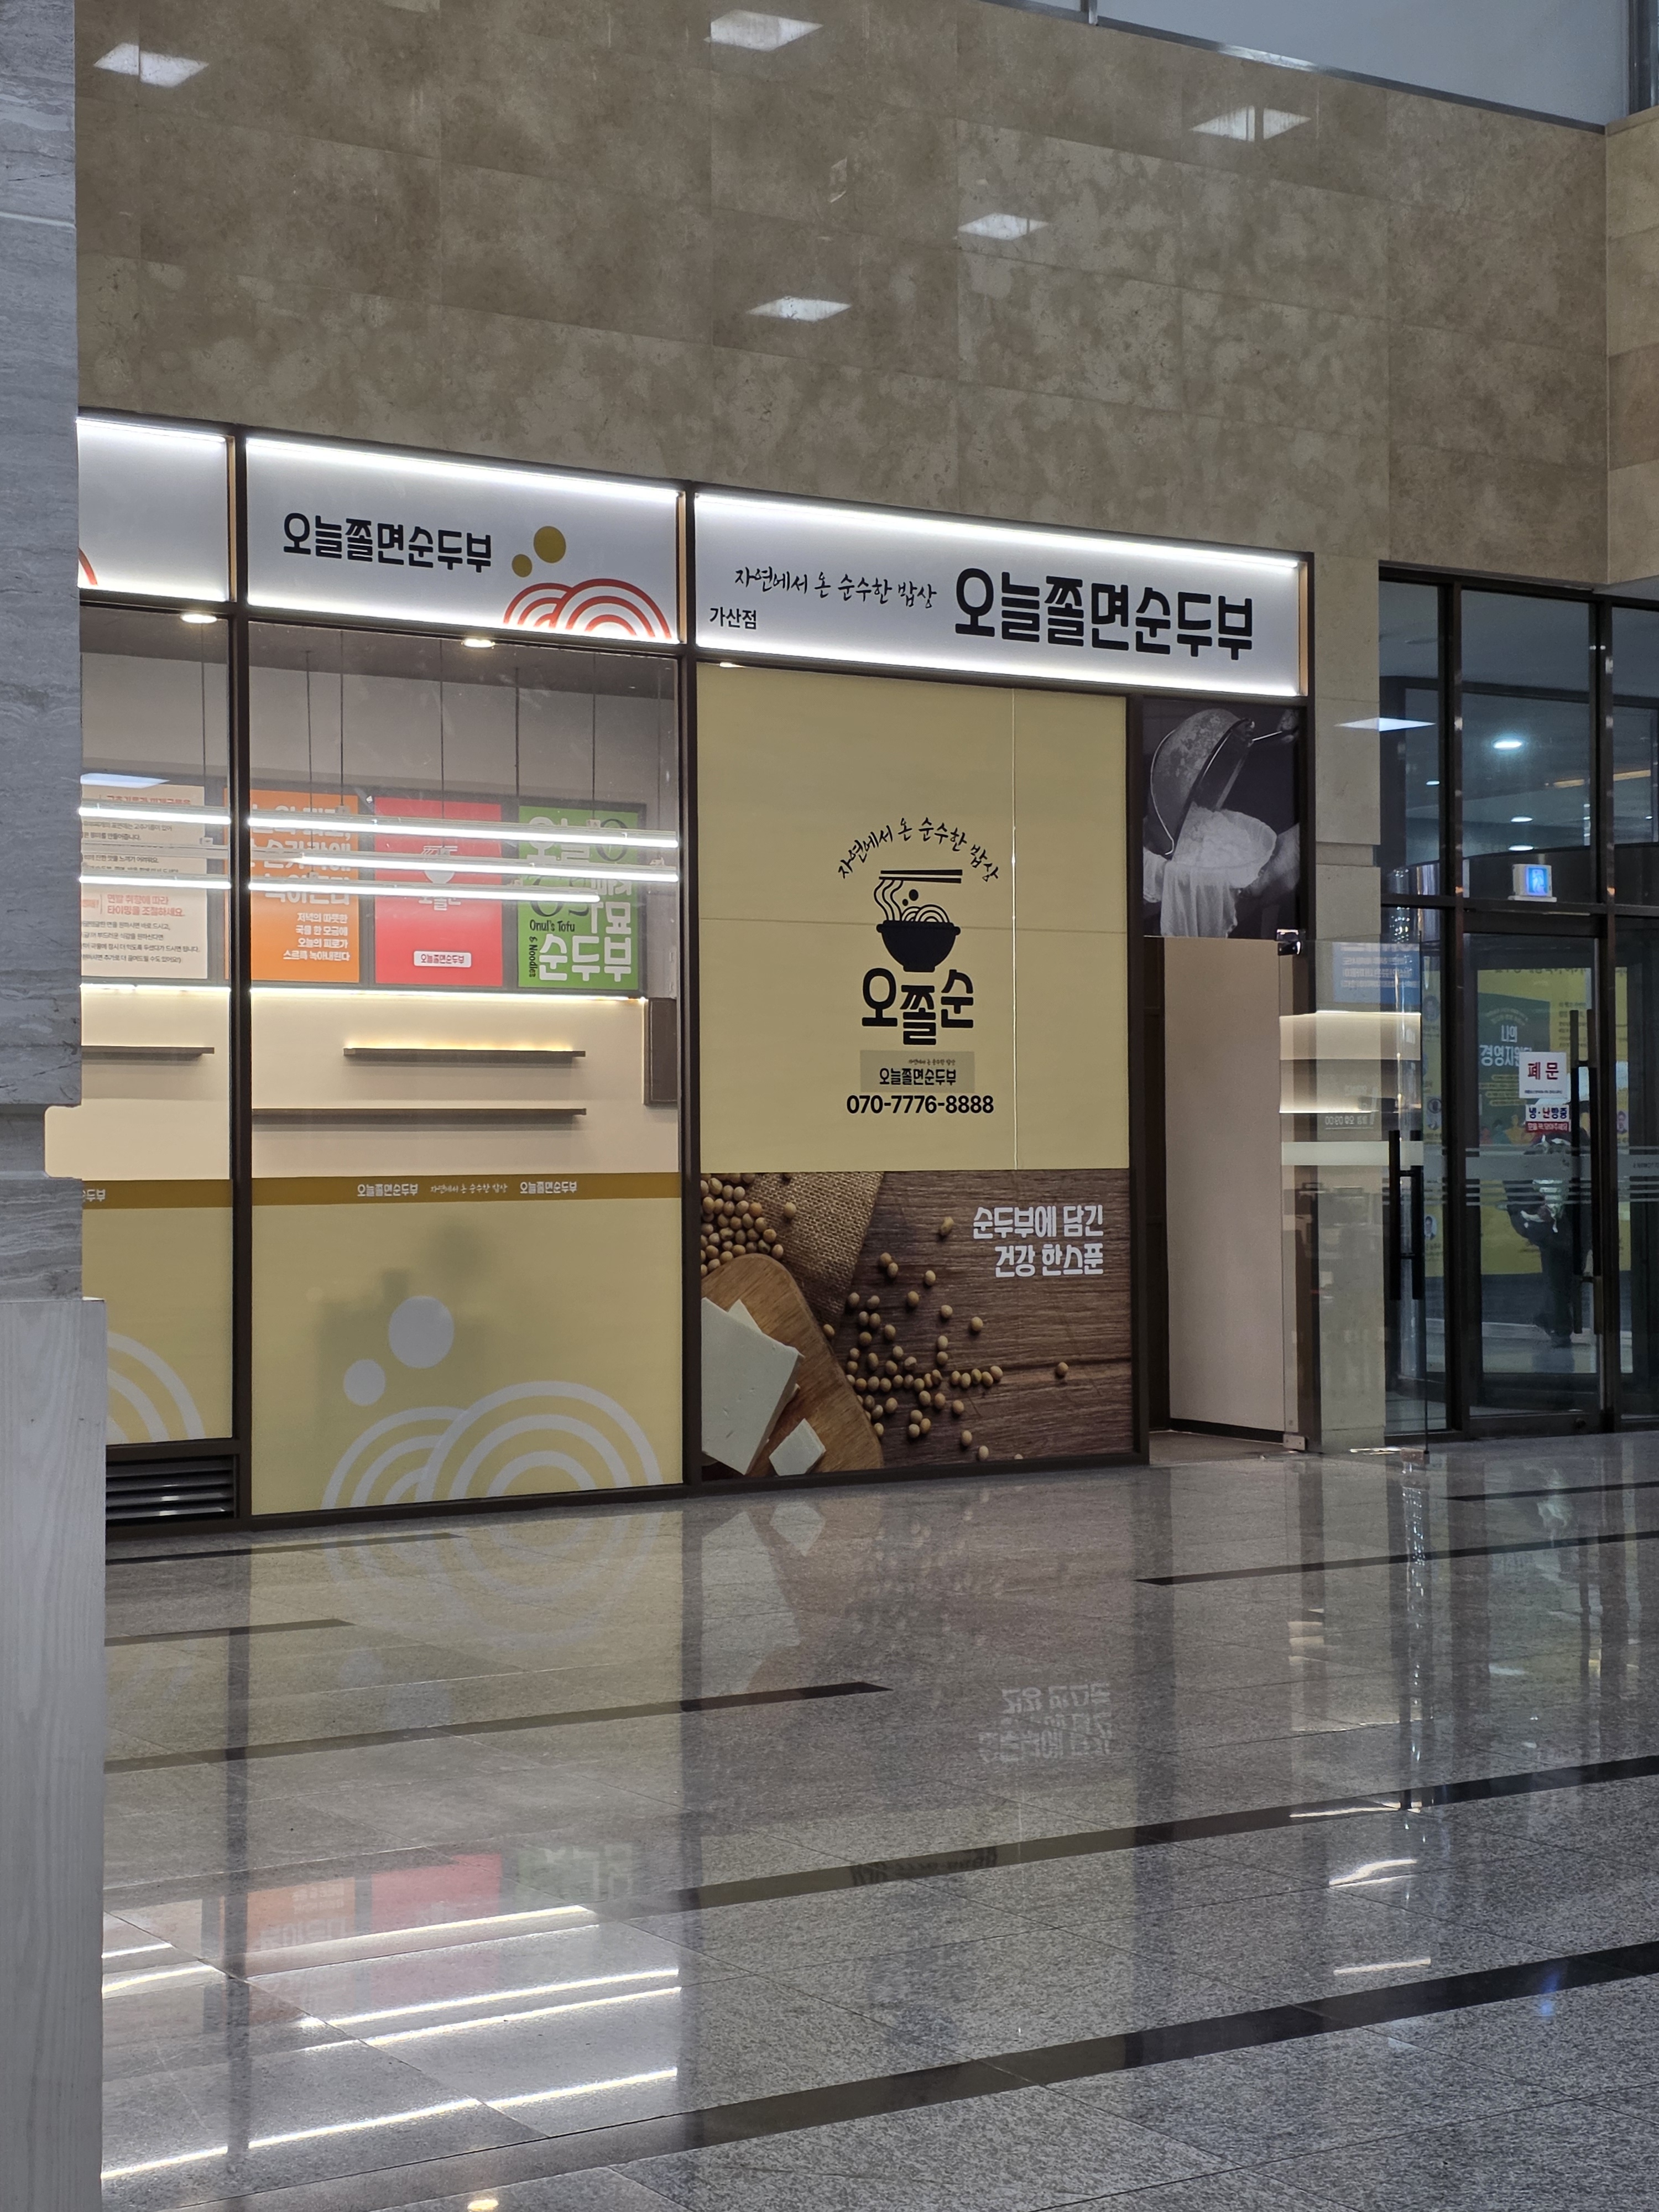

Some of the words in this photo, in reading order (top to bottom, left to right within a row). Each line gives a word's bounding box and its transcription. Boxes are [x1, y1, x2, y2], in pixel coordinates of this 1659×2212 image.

[283, 512, 492, 573] 오늘쫄면순두부
[734, 566, 809, 595] 자연에서
[813, 571, 832, 598] 온
[837, 573, 893, 604] 순수한
[898, 581, 937, 609] 밥상
[709, 606, 758, 630] 가산점
[954, 567, 1253, 661] 오늘쫄면순두부
[837, 825, 894, 880] 자연에서
[898, 817, 913, 842] 온
[918, 817, 968, 852] 순수한
[970, 844, 999, 883] 밥상
[298, 938, 322, 948] 오늘의
[529, 919, 555, 932] Onul's
[557, 920, 575, 932] Tofu
[539, 933, 632, 982] 순두부
[862, 967, 974, 1046] 오쫄순
[879, 1068, 957, 1086] 오늘쫄면순두부
[847, 1095, 994, 1114] 070-7776-8888
[972, 1206, 1057, 1240] 순두부에
[1062, 1204, 1104, 1238] 담긴
[994, 1244, 1036, 1278] 건강
[1041, 1242, 1104, 1276] 한스푼
